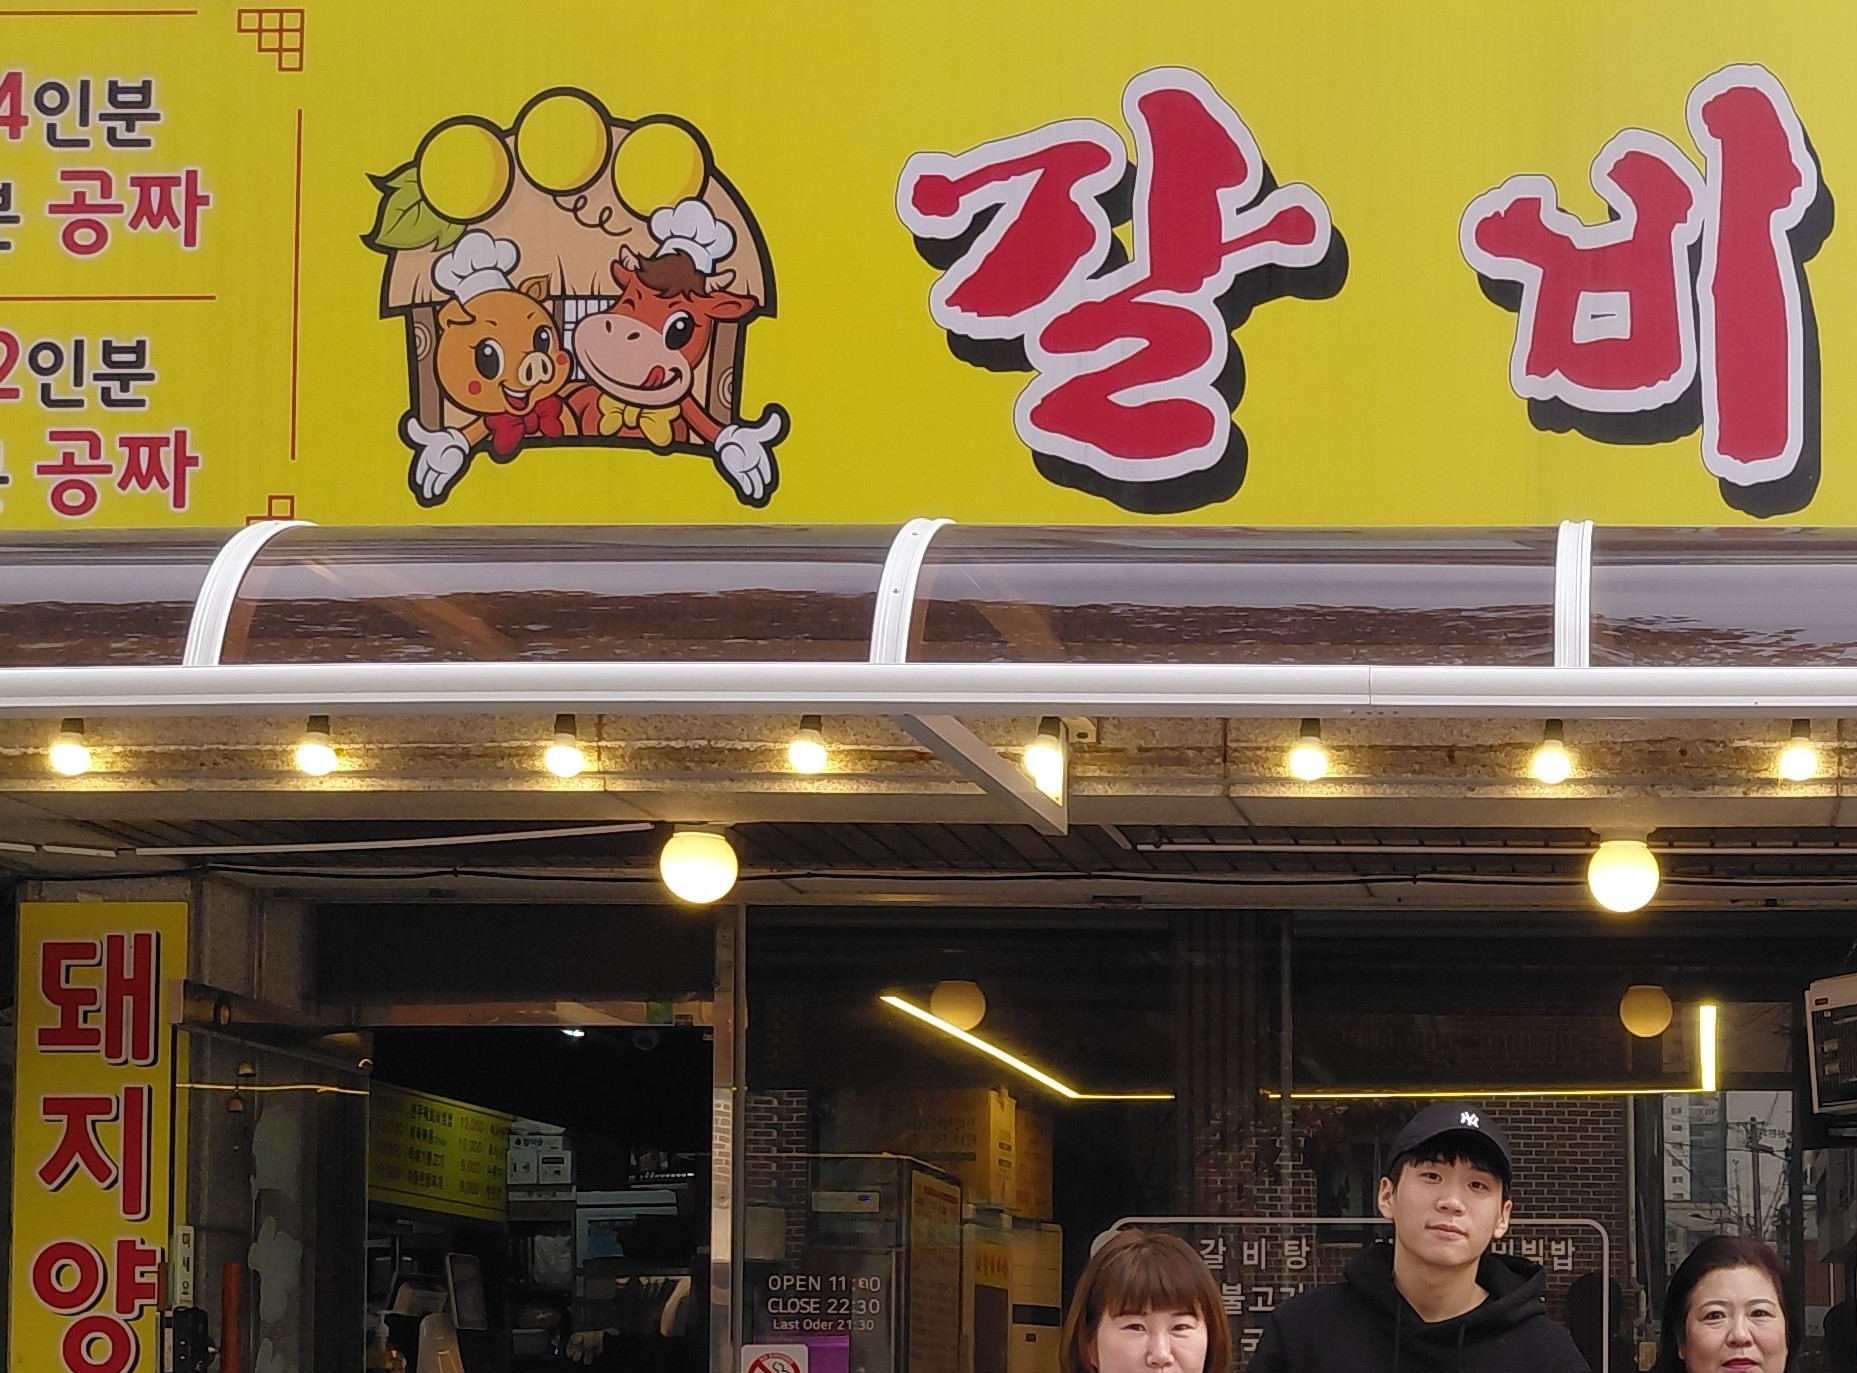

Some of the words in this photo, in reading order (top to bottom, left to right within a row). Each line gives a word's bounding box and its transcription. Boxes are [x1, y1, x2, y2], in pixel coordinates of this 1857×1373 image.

[48, 168, 210, 257] 공짜
[0, 330, 156, 410] 2인분
[35, 429, 200, 517] 공짜
[1200, 1237, 1311, 1270] 갈비탕
[768, 1275, 821, 1292] OPEN
[767, 1298, 820, 1314] CLOSE
[827, 1298, 881, 1315] 22:30
[772, 1319, 800, 1330] Last
[803, 1319, 833, 1331] Oder
[837, 1319, 874, 1331] 21:30
